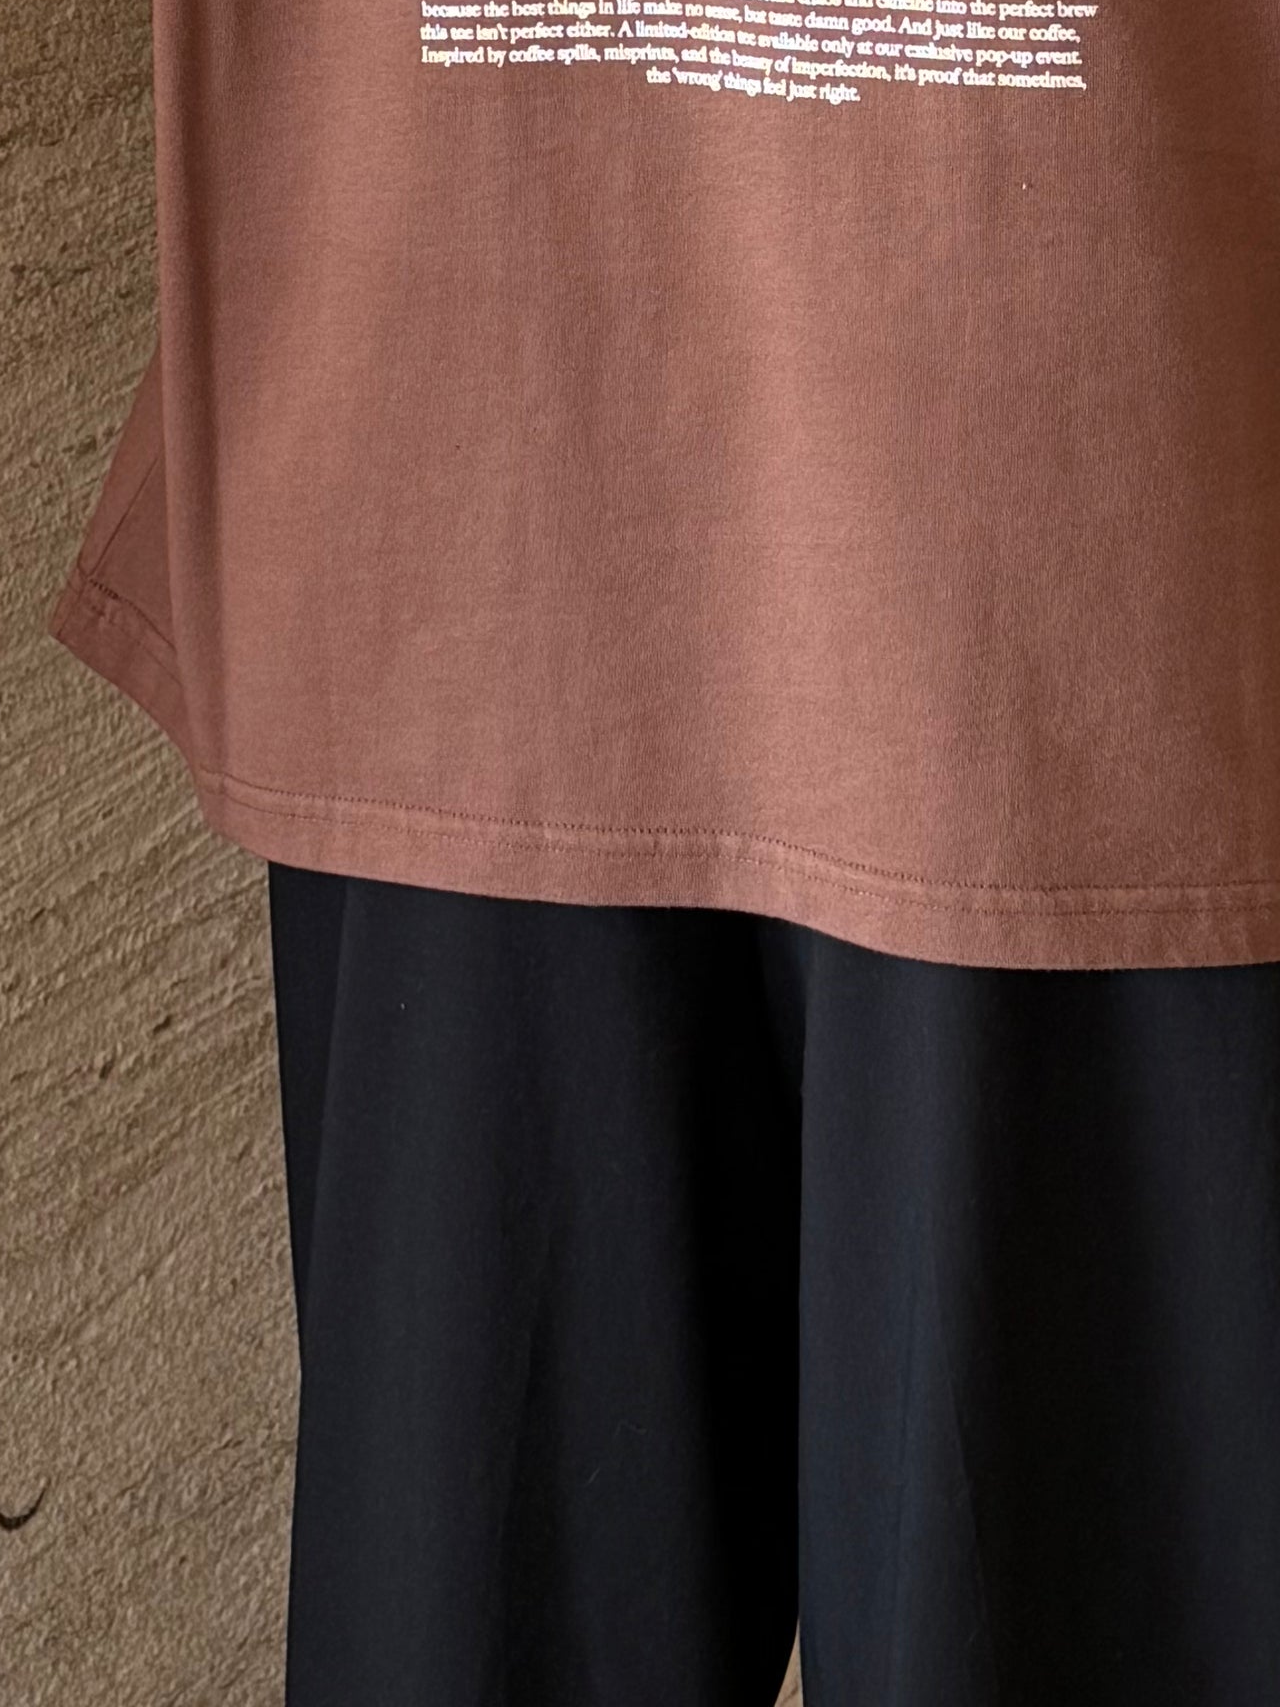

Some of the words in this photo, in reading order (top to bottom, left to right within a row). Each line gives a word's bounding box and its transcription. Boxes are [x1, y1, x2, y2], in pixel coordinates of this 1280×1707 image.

[484, 0, 510, 17] the
[511, 0, 545, 17] best
[685, 3, 704, 17] no
[744, 4, 767, 24] but
[804, 11, 850, 30] damn
[851, 15, 896, 36] good.
[898, 16, 933, 35] And
[932, 19, 965, 41] just
[966, 21, 996, 39] like
[997, 27, 1027, 40] our
[1028, 24, 1081, 44] coffee,
[999, 0, 1055, 21] perfect
[1057, 0, 1099, 17] brew
[420, 23, 449, 40] this
[510, 21, 564, 45] perfect
[566, 21, 616, 38] either.
[617, 20, 634, 37] A
[821, 36, 855, 59] only
[856, 41, 874, 55] at
[875, 43, 903, 57] our
[975, 49, 1034, 69] pop-up
[1035, 51, 1083, 65] event.
[421, 45, 485, 67] Inspired
[486, 46, 507, 68] by
[508, 44, 555, 62] coffee
[681, 45, 708, 63] and
[709, 46, 731, 65] the
[774, 55, 791, 73] of
[792, 56, 892, 82] imperfection,
[894, 63, 917, 82] it's
[918, 67, 963, 86] proof
[963, 68, 996, 86] that
[997, 70, 1087, 91] sometimes,
[646, 66, 672, 84] the
[724, 72, 762, 97] things
[786, 80, 818, 102] just
[819, 83, 861, 106] right.
